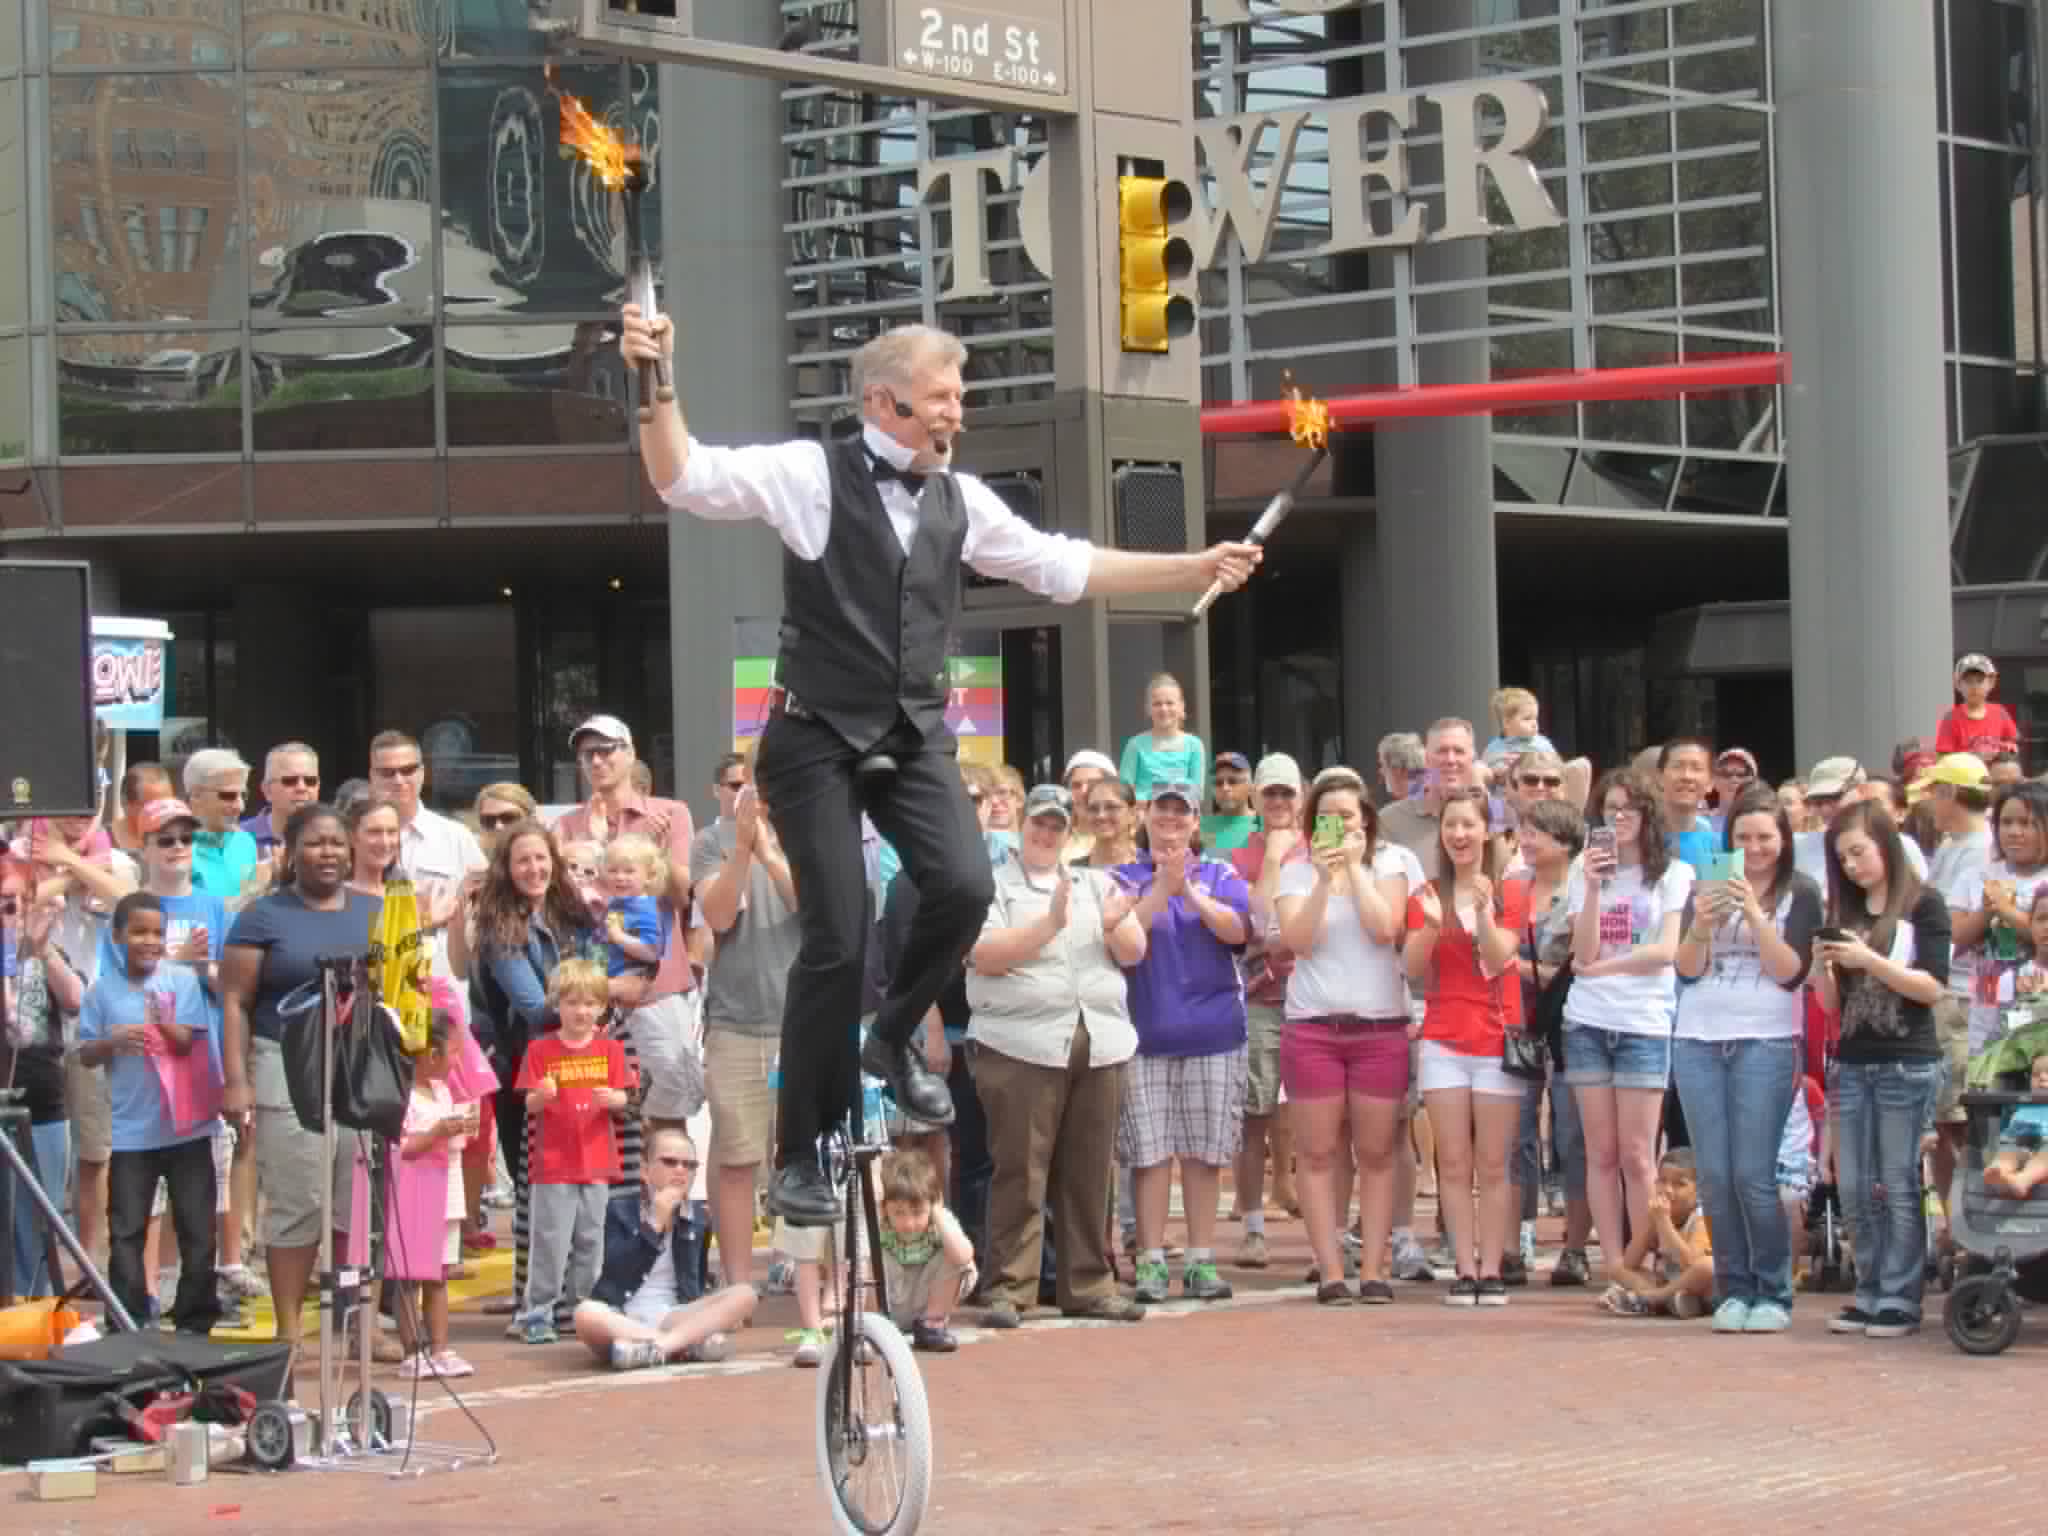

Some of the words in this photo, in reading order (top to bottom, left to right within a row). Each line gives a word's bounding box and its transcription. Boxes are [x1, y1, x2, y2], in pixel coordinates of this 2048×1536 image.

[919, 7, 990, 57] 2nd
[1004, 24, 1041, 66] St
[919, 48, 975, 76] W-100
[992, 60, 1040, 86] E-100
